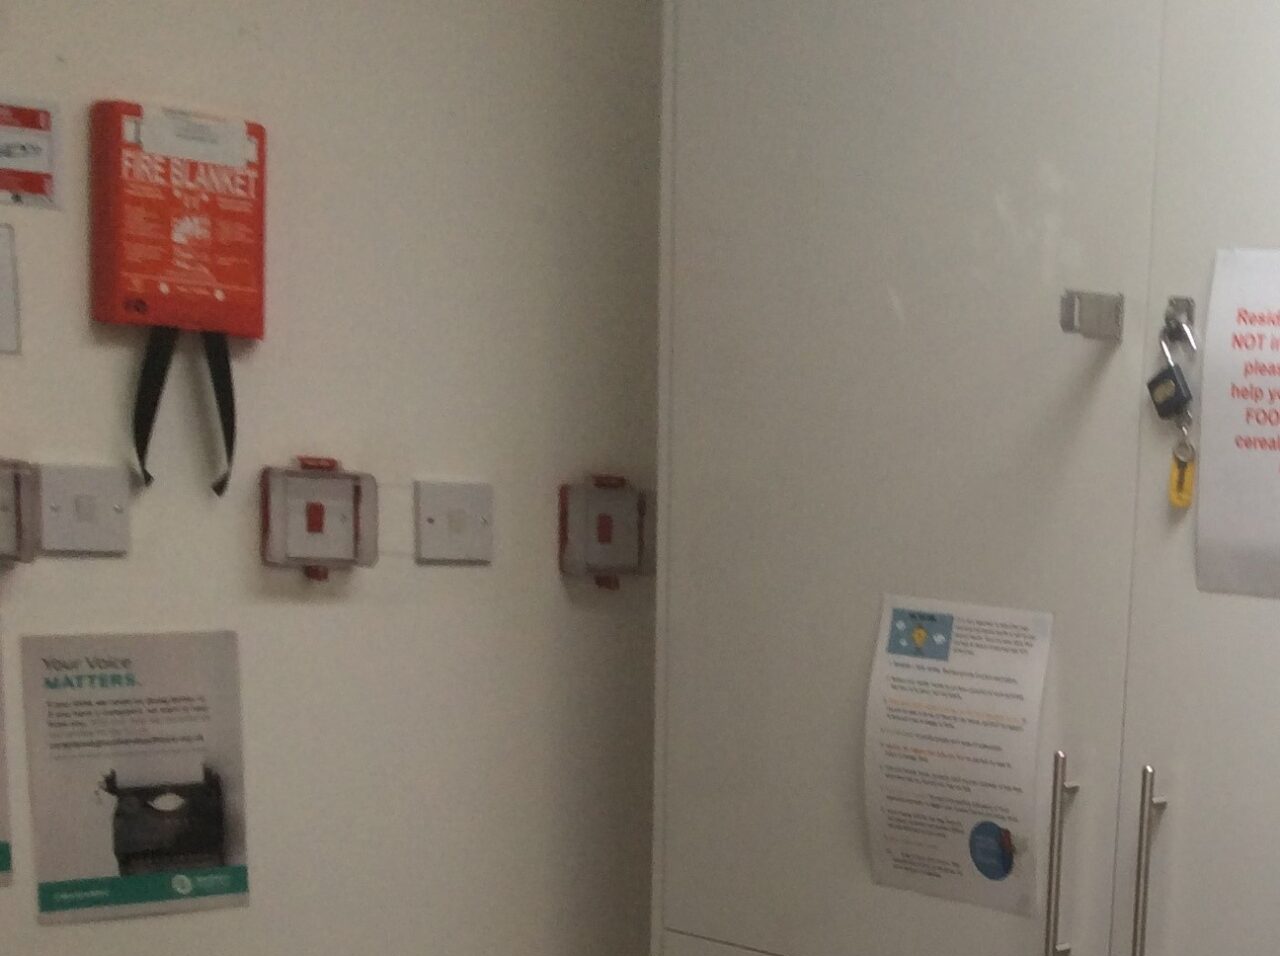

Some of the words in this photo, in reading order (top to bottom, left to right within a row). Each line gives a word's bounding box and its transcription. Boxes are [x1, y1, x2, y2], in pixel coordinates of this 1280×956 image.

[121, 148, 166, 187] FIRE
[170, 157, 258, 200] BLANKET
[1231, 332, 1265, 350] NOT
[1230, 384, 1264, 403] help
